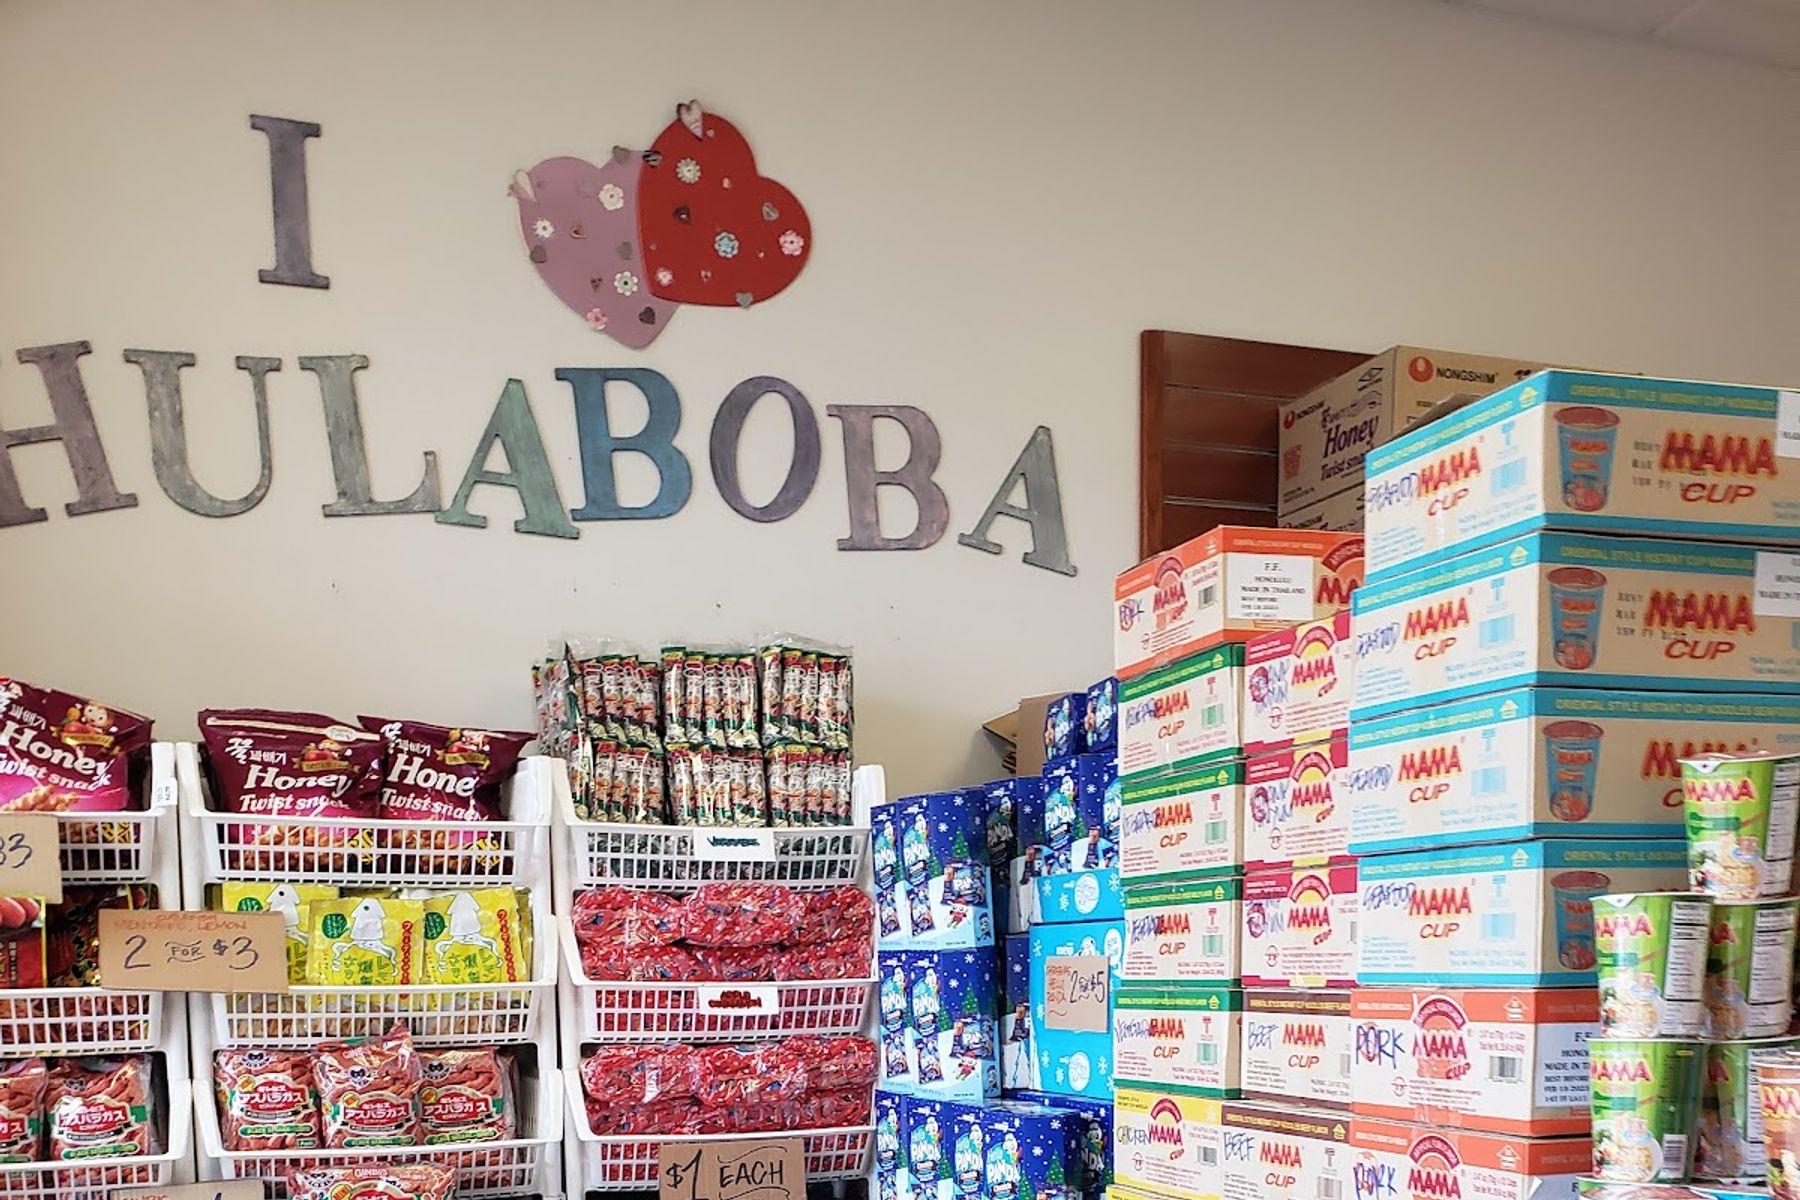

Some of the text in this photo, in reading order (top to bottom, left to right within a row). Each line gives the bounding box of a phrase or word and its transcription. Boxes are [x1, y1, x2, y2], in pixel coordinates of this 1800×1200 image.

[249, 113, 330, 290] I
[1436, 366, 1496, 385] NONGSHIM
[1322, 414, 1380, 459] Honey
[1659, 429, 1779, 478] MAMA
[1418, 446, 1482, 501] MAMA
[1427, 488, 1470, 517] CUP
[1680, 483, 1756, 504] CUP
[1153, 583, 1187, 614] MAMA
[1317, 575, 1364, 604] MA
[1404, 597, 1470, 641] MAMA
[1644, 590, 1756, 632] MAMA
[1414, 637, 1457, 661] CUP
[1664, 638, 1736, 660] CUP
[1292, 656, 1337, 686] MAMA
[1608, 700, 1640, 712] STYLE
[1157, 720, 1185, 740] CUP
[1, 720, 116, 779] Honey
[387, 753, 481, 798] Hone
[1399, 745, 1462, 782] MAMA
[243, 763, 355, 799] Honey
[1685, 778, 1755, 802] MAMA
[239, 794, 294, 814] Twist
[379, 787, 430, 811] Twist
[1291, 782, 1333, 808] MAMA
[1409, 783, 1450, 804] CUP
[0, 832, 33, 869] 3
[1160, 832, 1188, 848] CUP
[1615, 851, 1647, 862] STYLE
[1409, 885, 1473, 917] MAMA
[1287, 906, 1331, 929] MAMA
[1313, 929, 1333, 946] CUP
[1420, 922, 1461, 940] CUP
[124, 934, 260, 970] 2 FOR $3
[1159, 943, 1186, 956] CUP
[1069, 970, 1078, 1003] 2
[1090, 970, 1105, 1003] $5
[1283, 1022, 1327, 1047] MAMA
[1412, 1030, 1468, 1060] MAMA
[1153, 1046, 1180, 1059] CUP
[1355, 1024, 1406, 1070] PORK
[1561, 1049, 1590, 1058] HONO
[1288, 1054, 1320, 1069] CUP
[1445, 1062, 1472, 1080] CUP
[1544, 1062, 1581, 1071] MADE IN
[237, 1092, 305, 1105] アスパラガス
[423, 1101, 488, 1116] アスパラガス
[345, 1107, 408, 1120] アスパラガス
[1149, 1124, 1184, 1147] MAMA
[1169, 1148, 1185, 1161] CUP
[1260, 1140, 1303, 1169] MAMA
[718, 1159, 784, 1188] EACH
[1265, 1172, 1297, 1188] CUP
[1407, 1167, 1462, 1200] MAMA
